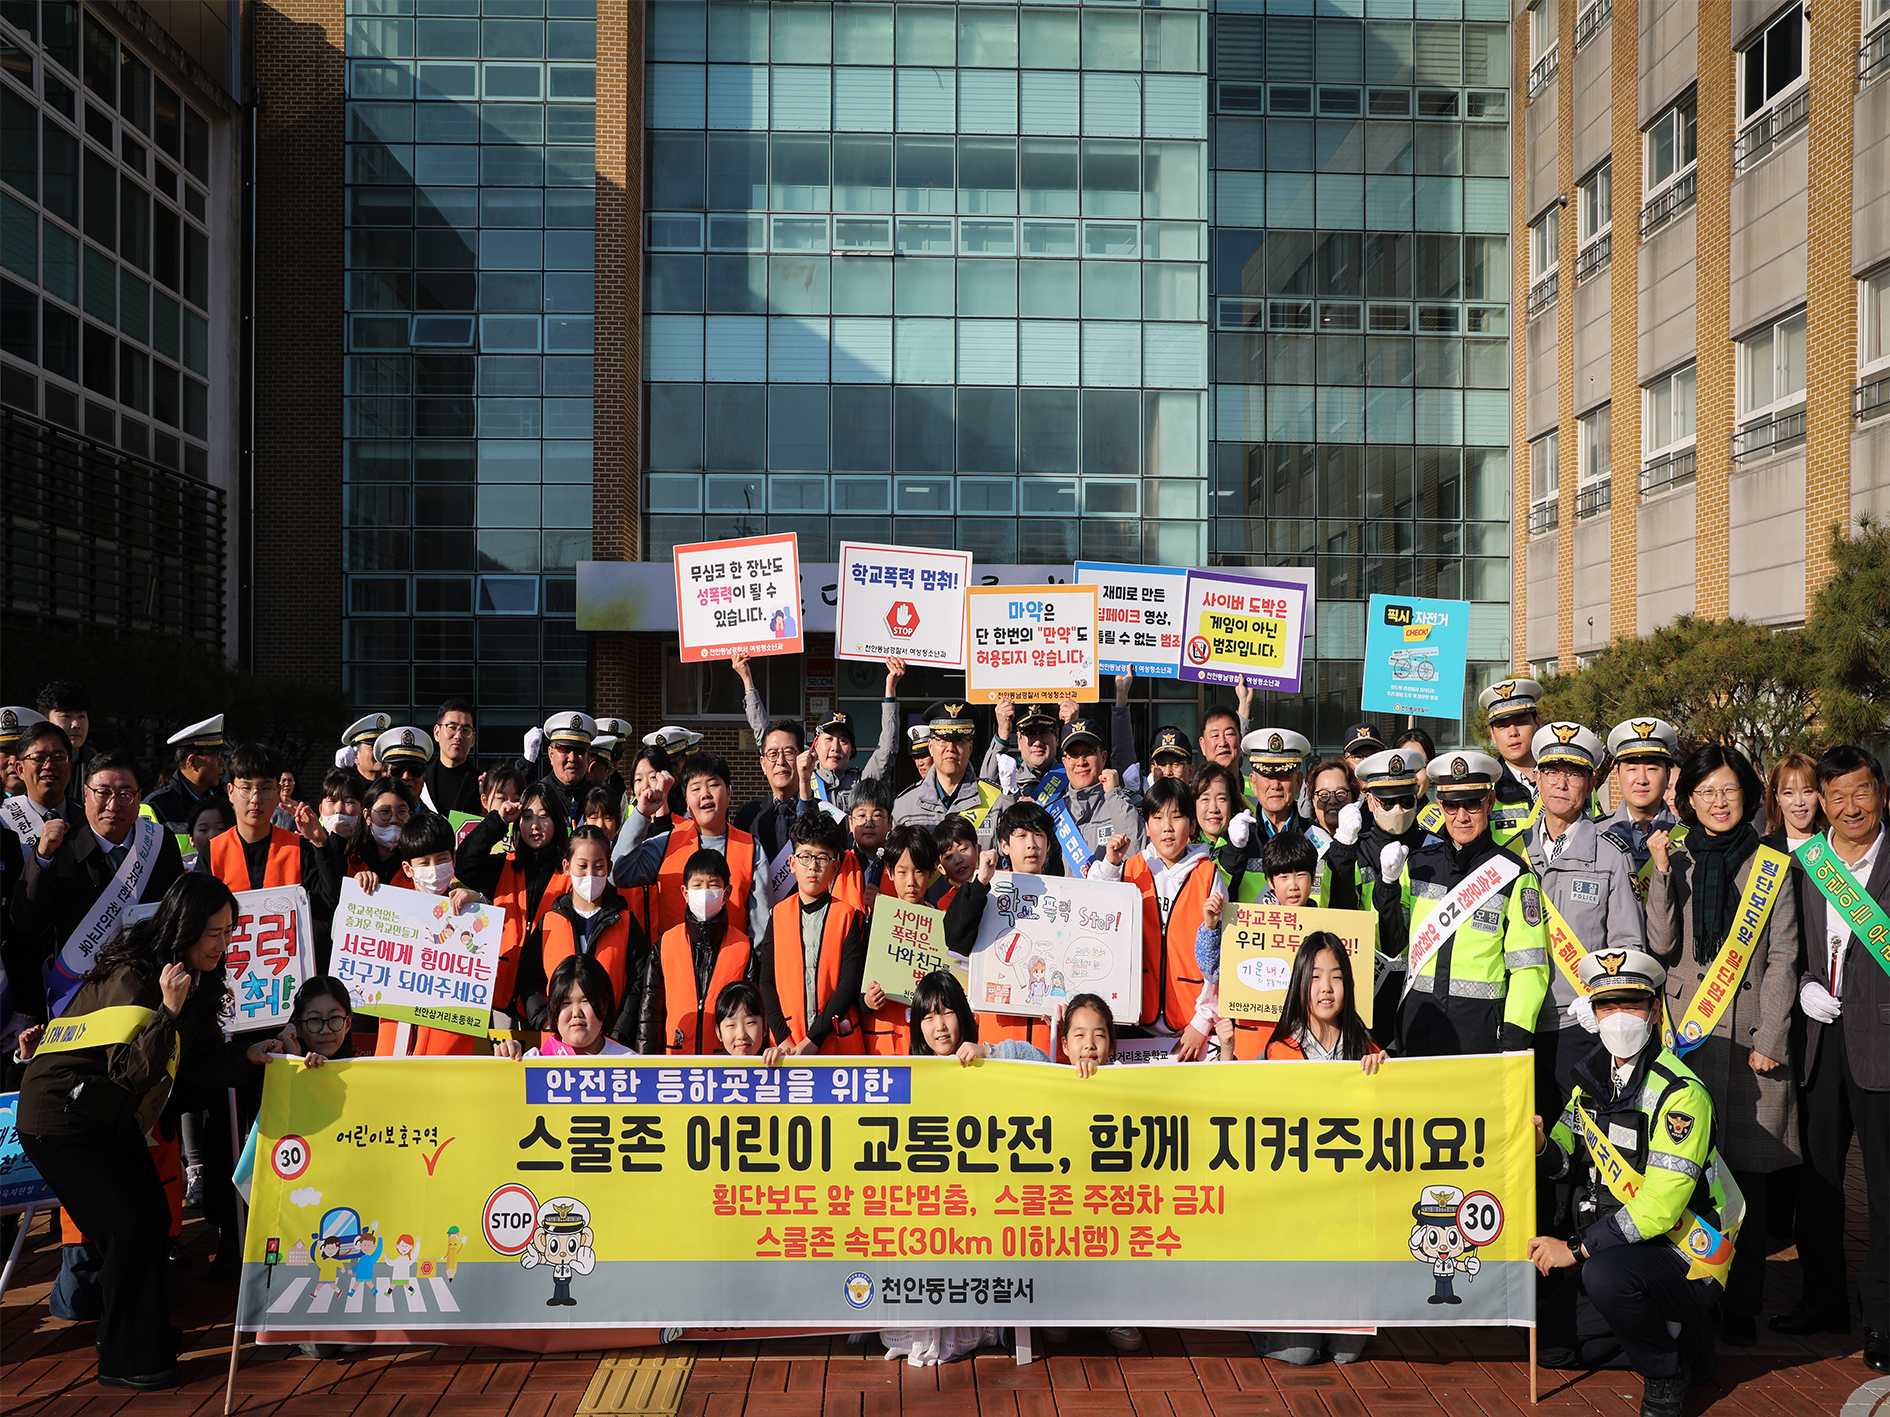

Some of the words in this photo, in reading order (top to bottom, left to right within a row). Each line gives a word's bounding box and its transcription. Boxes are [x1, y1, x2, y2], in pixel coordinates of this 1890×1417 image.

[691, 563, 725, 582] 무심코
[729, 561, 743, 580] 한
[746, 557, 783, 578] 장난도
[852, 562, 915, 589] 학교폭력
[920, 569, 959, 591] 멈춰!
[697, 585, 746, 606] 성폭력이
[749, 583, 762, 601] 될
[766, 582, 777, 598] 수
[1102, 585, 1138, 601] 재미로
[1141, 587, 1165, 603] 만든
[1202, 591, 1245, 611] 사이버
[1249, 597, 1288, 619] 도박은
[714, 607, 767, 628] 있습니다.
[1008, 601, 1055, 623] 마약은
[1144, 610, 1171, 627] 영상,
[1387, 608, 1410, 624] 픽시
[1414, 611, 1449, 627] 자전거
[893, 626, 914, 636] STOP
[976, 628, 989, 645] 단
[993, 627, 1033, 645] 한번의
[1037, 626, 1088, 644] "만약"도
[1118, 631, 1131, 646] 수
[1133, 632, 1157, 647] 없는
[1209, 615, 1248, 634] 게임이
[1251, 621, 1278, 639] 아닌
[1405, 628, 1429, 637] CHECK!
[749, 642, 784, 653] 여성청소년과
[865, 644, 908, 655] 천안동남경찰서
[909, 648, 947, 659] 여성청소년과
[976, 650, 1027, 668] 허용되지
[1031, 649, 1084, 668] 않습니다
[1213, 637, 1278, 659] 범죄입니다.
[807, 677, 834, 686] SECOM
[1138, 664, 1173, 675] 여성청소년과
[1245, 676, 1281, 688] 여성청소년과
[1041, 690, 1078, 699] 여성청소년과
[1065, 835, 1086, 865] 대한
[118, 860, 146, 905] 안전한
[1457, 866, 1501, 911] 과속운전
[1816, 859, 1873, 926] 어린이는
[994, 881, 1040, 927] 학교
[1042, 896, 1072, 924] 폭력
[1573, 893, 1597, 902] POLICE
[347, 902, 400, 923] 학교폭력없는
[893, 908, 933, 934] 사이버
[1237, 908, 1303, 931] 학교폭력,
[1438, 901, 1462, 928] NO
[1475, 911, 1498, 924] 모범
[78, 900, 122, 959] 천안교육
[345, 916, 372, 931] 즐거운
[375, 921, 420, 940] 학교만들기
[891, 925, 939, 952] 폭력은...
[225, 910, 297, 980] 폭력
[1235, 931, 1265, 951] 우리
[340, 933, 414, 966] 서로에게
[420, 947, 492, 981] 힘이되는
[888, 944, 915, 966] 나와
[337, 957, 392, 987] 친구가
[397, 969, 488, 1005] 되어주세요
[1697, 949, 1744, 1019] 일단멈춤
[241, 971, 296, 1018] 춰!
[413, 1006, 482, 1028] 천안삼거리초등학교
[546, 1068, 641, 1103] 안전한
[655, 1067, 815, 1103] 등하굣길을
[831, 1067, 894, 1103] 위한
[336, 1124, 439, 1149] 어린이보호구역
[516, 1114, 666, 1173] 스쿨존
[686, 1114, 832, 1173] 어린이
[853, 1114, 1071, 1177] 교통안전,
[1089, 1113, 1190, 1174] 함께
[1208, 1116, 1486, 1173] 지켜주세요!
[280, 1146, 302, 1168] 30
[712, 1183, 817, 1217] 횡단보도
[827, 1183, 854, 1216] 앞
[862, 1183, 977, 1218] 일단멈춤,
[994, 1183, 1074, 1216] 스쿨존
[1083, 1183, 1164, 1216] 주정차
[1172, 1184, 1225, 1216] 금지
[491, 1212, 533, 1229] STOP
[1464, 1202, 1496, 1231] 30
[755, 1225, 835, 1258] 스쿨존
[844, 1225, 992, 1258] 속도(30km
[1001, 1225, 1120, 1259] 이하서행)
[1128, 1225, 1182, 1258] 준수
[880, 1276, 1035, 1305] 천안동남경찰서
